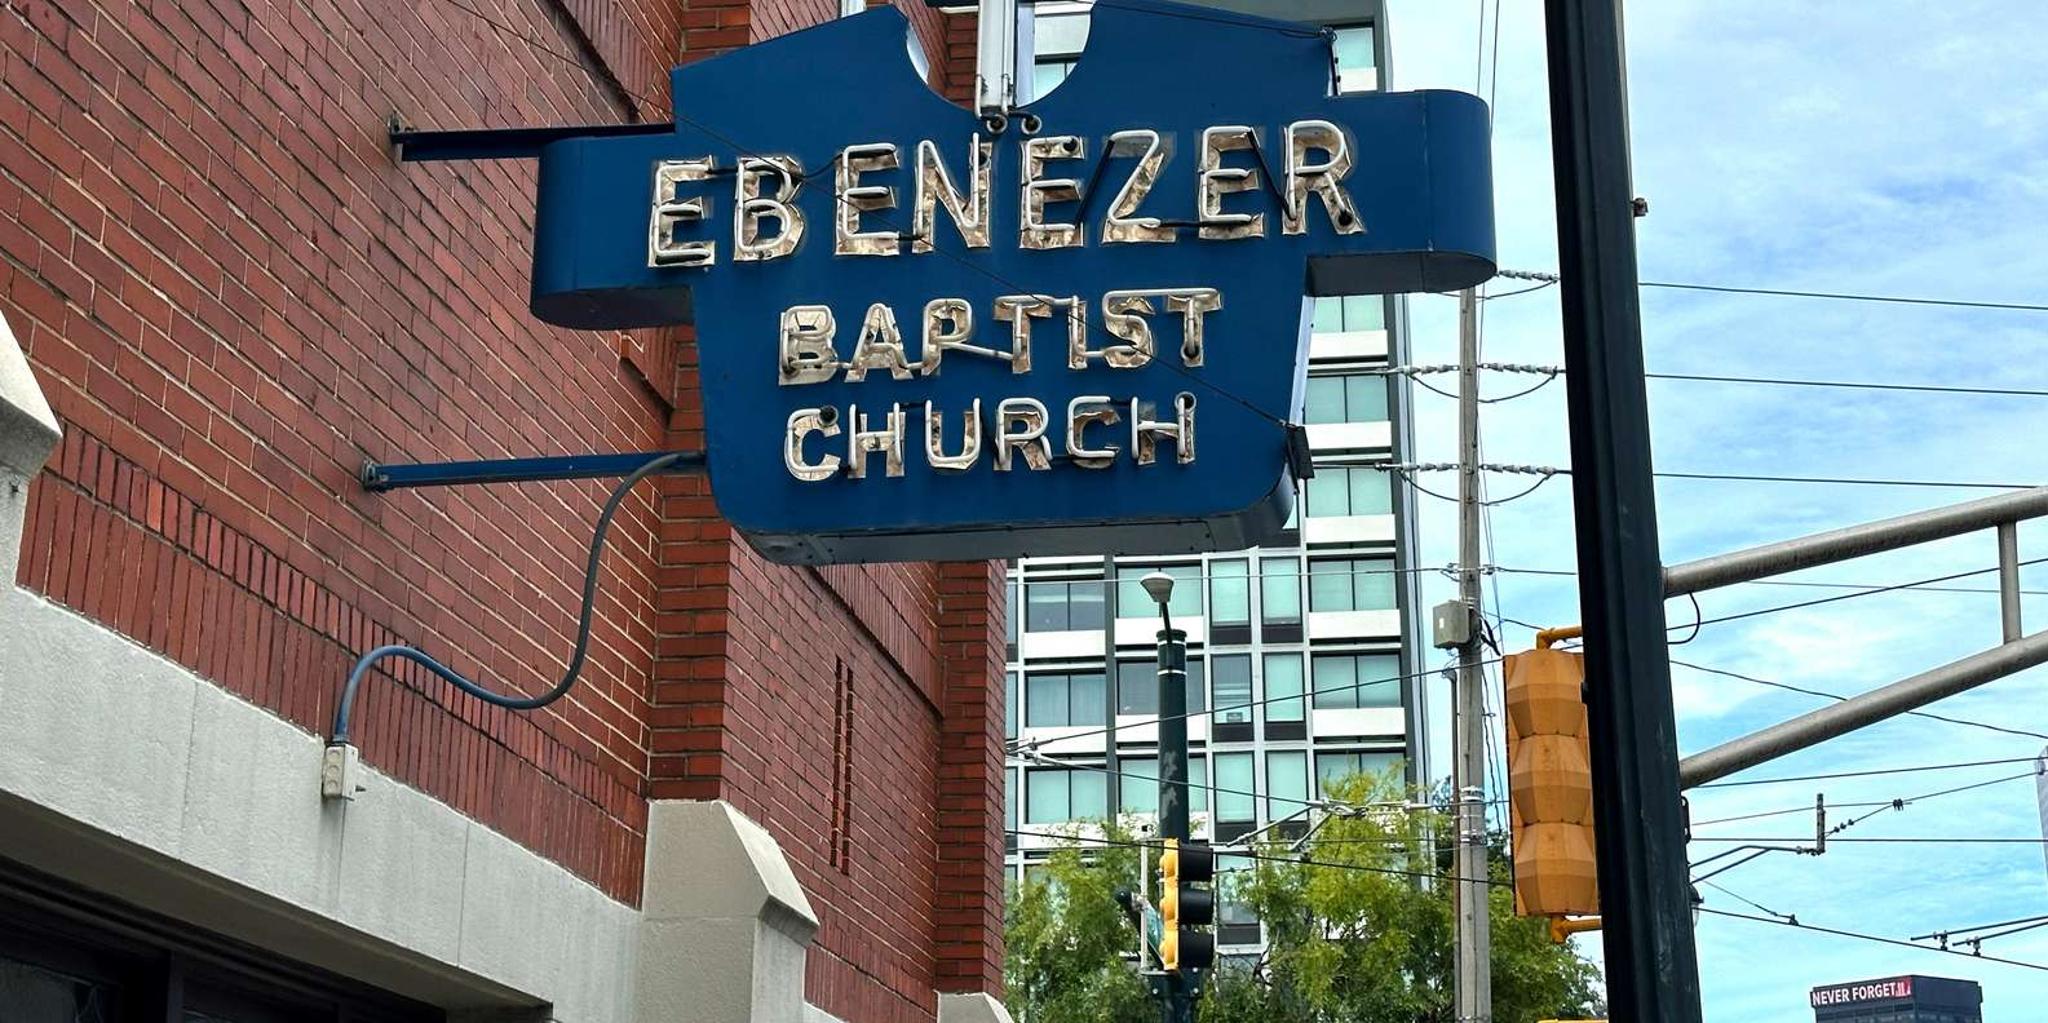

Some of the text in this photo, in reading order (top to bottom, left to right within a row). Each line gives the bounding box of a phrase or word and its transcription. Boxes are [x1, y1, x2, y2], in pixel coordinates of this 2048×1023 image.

[648, 119, 1365, 269] EBENEZER
[779, 287, 1223, 386] BAPTIST
[784, 391, 1196, 482] CHURCH
[1812, 990, 1850, 1006] NEVER
